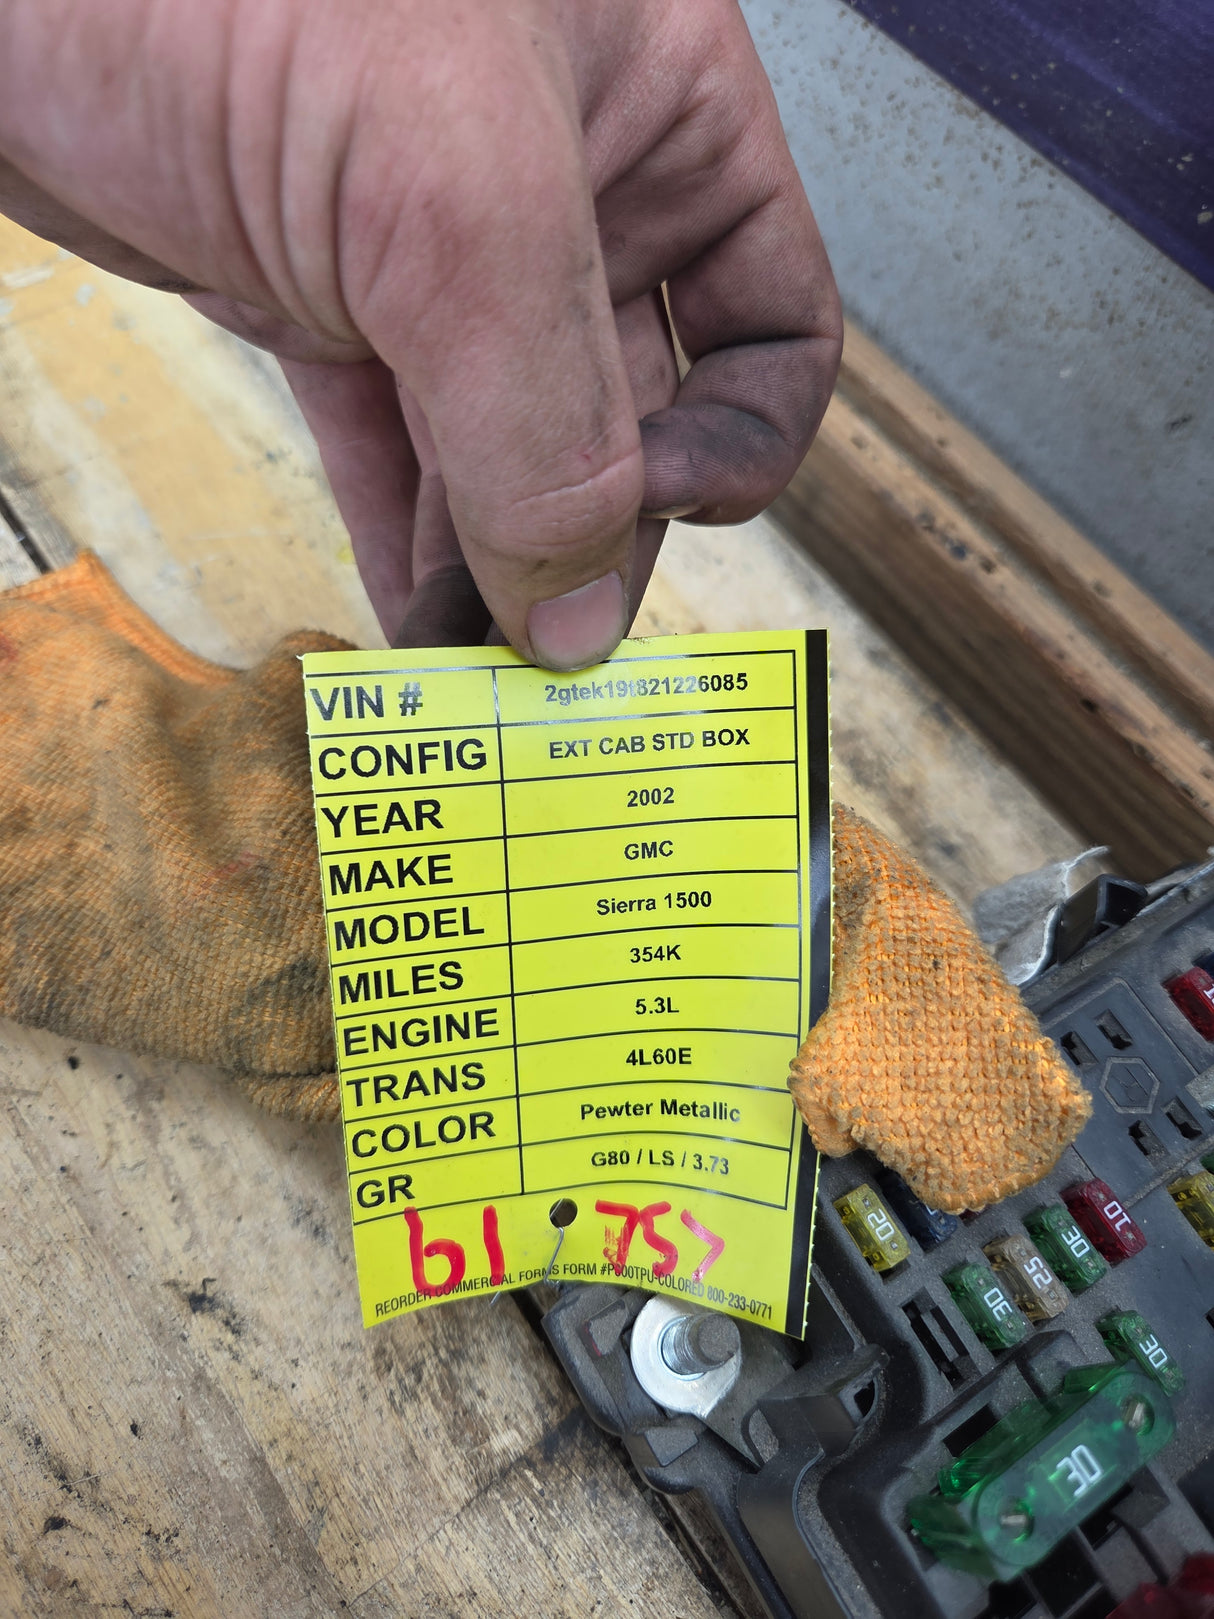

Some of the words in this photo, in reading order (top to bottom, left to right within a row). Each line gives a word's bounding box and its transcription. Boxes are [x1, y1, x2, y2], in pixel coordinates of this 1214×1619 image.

[310, 685, 384, 721] VIN
[398, 683, 424, 716] #
[545, 673, 748, 706] 2gtek19t821226085
[319, 738, 487, 780] CONFIG
[550, 740, 593, 759] EXT
[599, 736, 645, 755] CAB
[652, 732, 694, 751] STD
[702, 729, 750, 747] BOX
[627, 787, 675, 807] 2002
[320, 799, 444, 838] YEAR
[624, 840, 674, 860] GMC
[329, 854, 453, 896] MAKE
[597, 896, 657, 915] Sierra
[664, 891, 712, 908] 1500
[335, 906, 485, 951] MODEL
[630, 945, 681, 963] 354K
[339, 961, 463, 1005] MILES
[635, 997, 680, 1015] 5.3L
[343, 1008, 499, 1056] ENGINE
[626, 1047, 692, 1066] 4L60E
[346, 1062, 486, 1107] TRANS
[581, 1101, 653, 1120] Pewter
[660, 1098, 741, 1122] Metallic
[352, 1111, 496, 1158] COLOR
[591, 1150, 630, 1167] G80
[637, 1149, 643, 1165] /
[649, 1149, 675, 1166] LS
[681, 1151, 687, 1167] /
[693, 1153, 730, 1175] 3.73
[357, 1174, 415, 1208] GR
[867, 1208, 895, 1241] 20
[1103, 1200, 1132, 1232] 10
[1061, 1225, 1090, 1258] 30
[1023, 1256, 1053, 1290] 25
[375, 1285, 432, 1318] REORDER
[519, 1265, 559, 1281] FORMS
[563, 1263, 597, 1275] FORM
[707, 1286, 773, 1320] 800-233-0771
[984, 1287, 1013, 1322] 30
[1139, 1334, 1168, 1369] 30
[1055, 1443, 1105, 1499] 30
